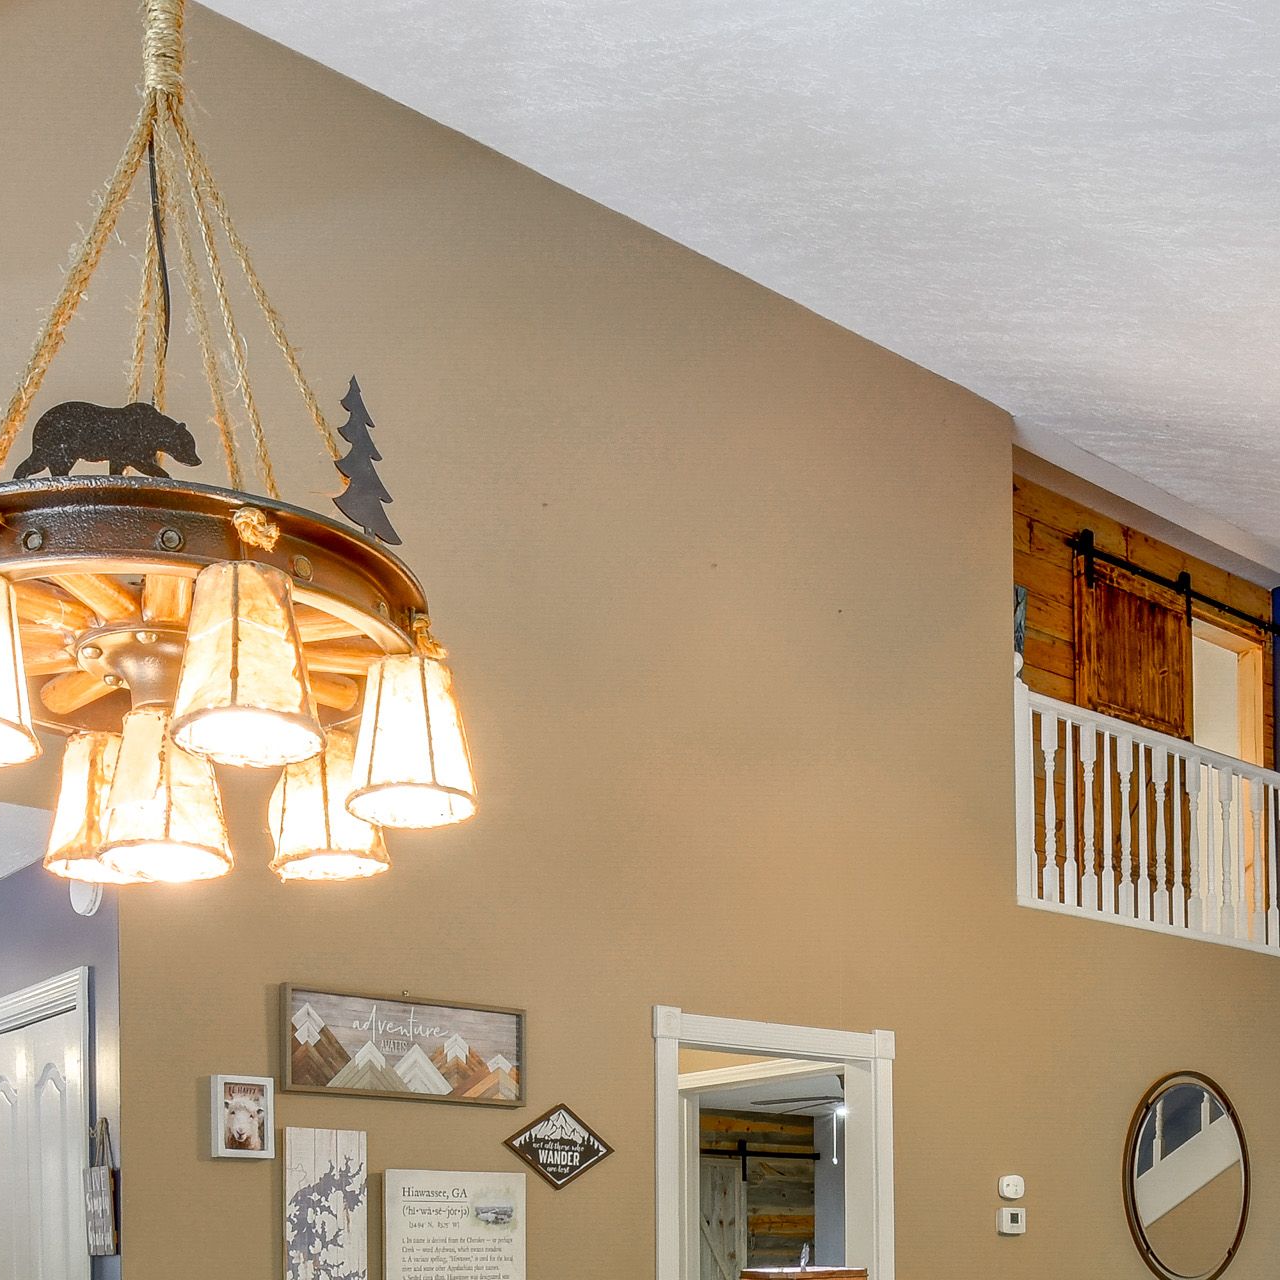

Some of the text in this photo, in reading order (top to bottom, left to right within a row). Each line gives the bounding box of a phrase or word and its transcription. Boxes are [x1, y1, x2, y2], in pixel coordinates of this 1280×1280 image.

[352, 1004, 448, 1043] adventure
[538, 1149, 580, 1166] WANDER
[402, 1186, 467, 1200] Hiawassee, GA
